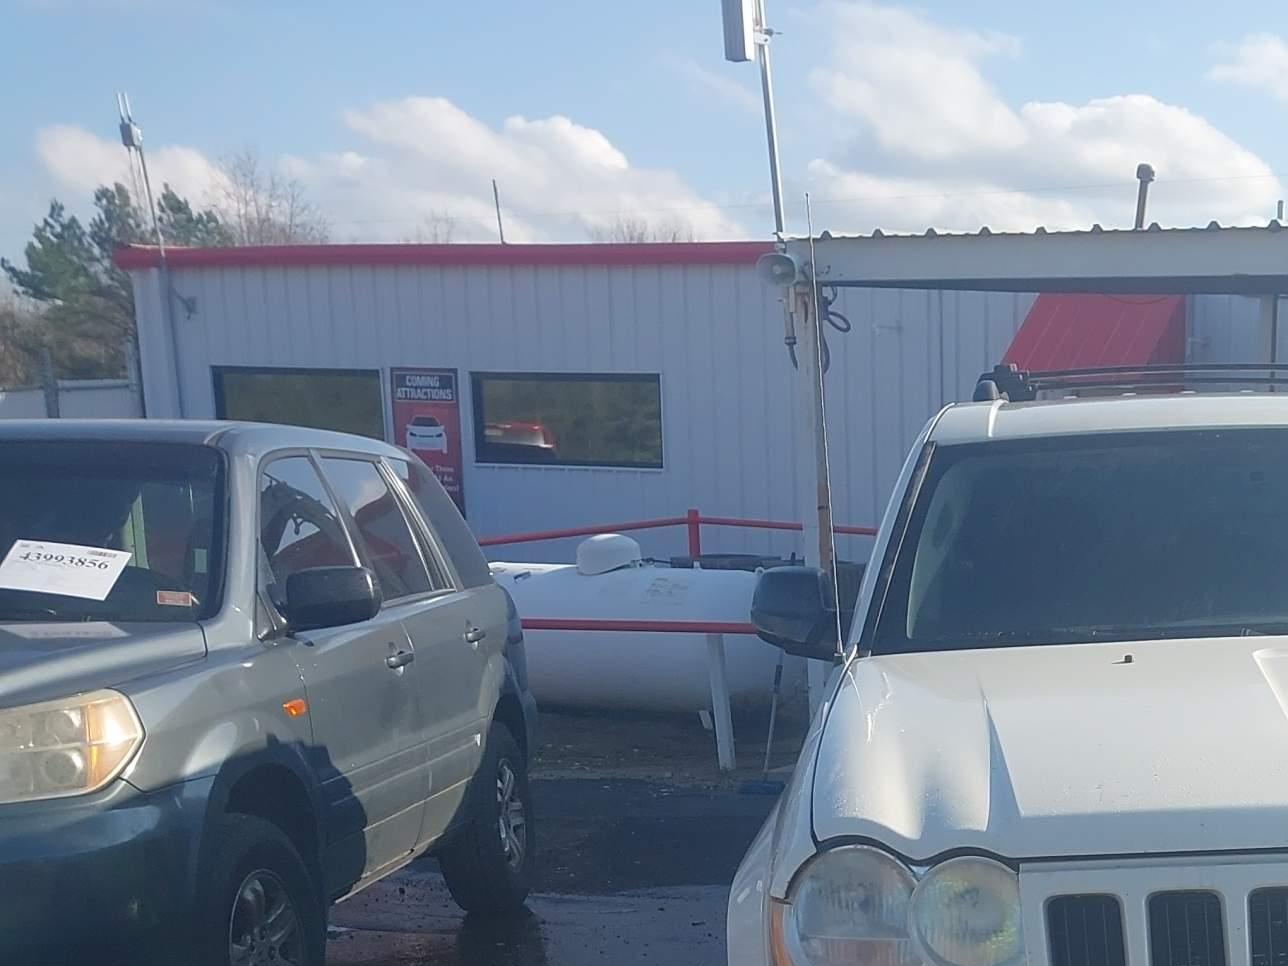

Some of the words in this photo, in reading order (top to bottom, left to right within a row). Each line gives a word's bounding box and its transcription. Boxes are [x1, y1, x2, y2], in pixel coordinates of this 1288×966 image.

[406, 375, 440, 388] COMING
[397, 387, 452, 400] ATTRACTIONS
[19, 551, 110, 570] 43993856
